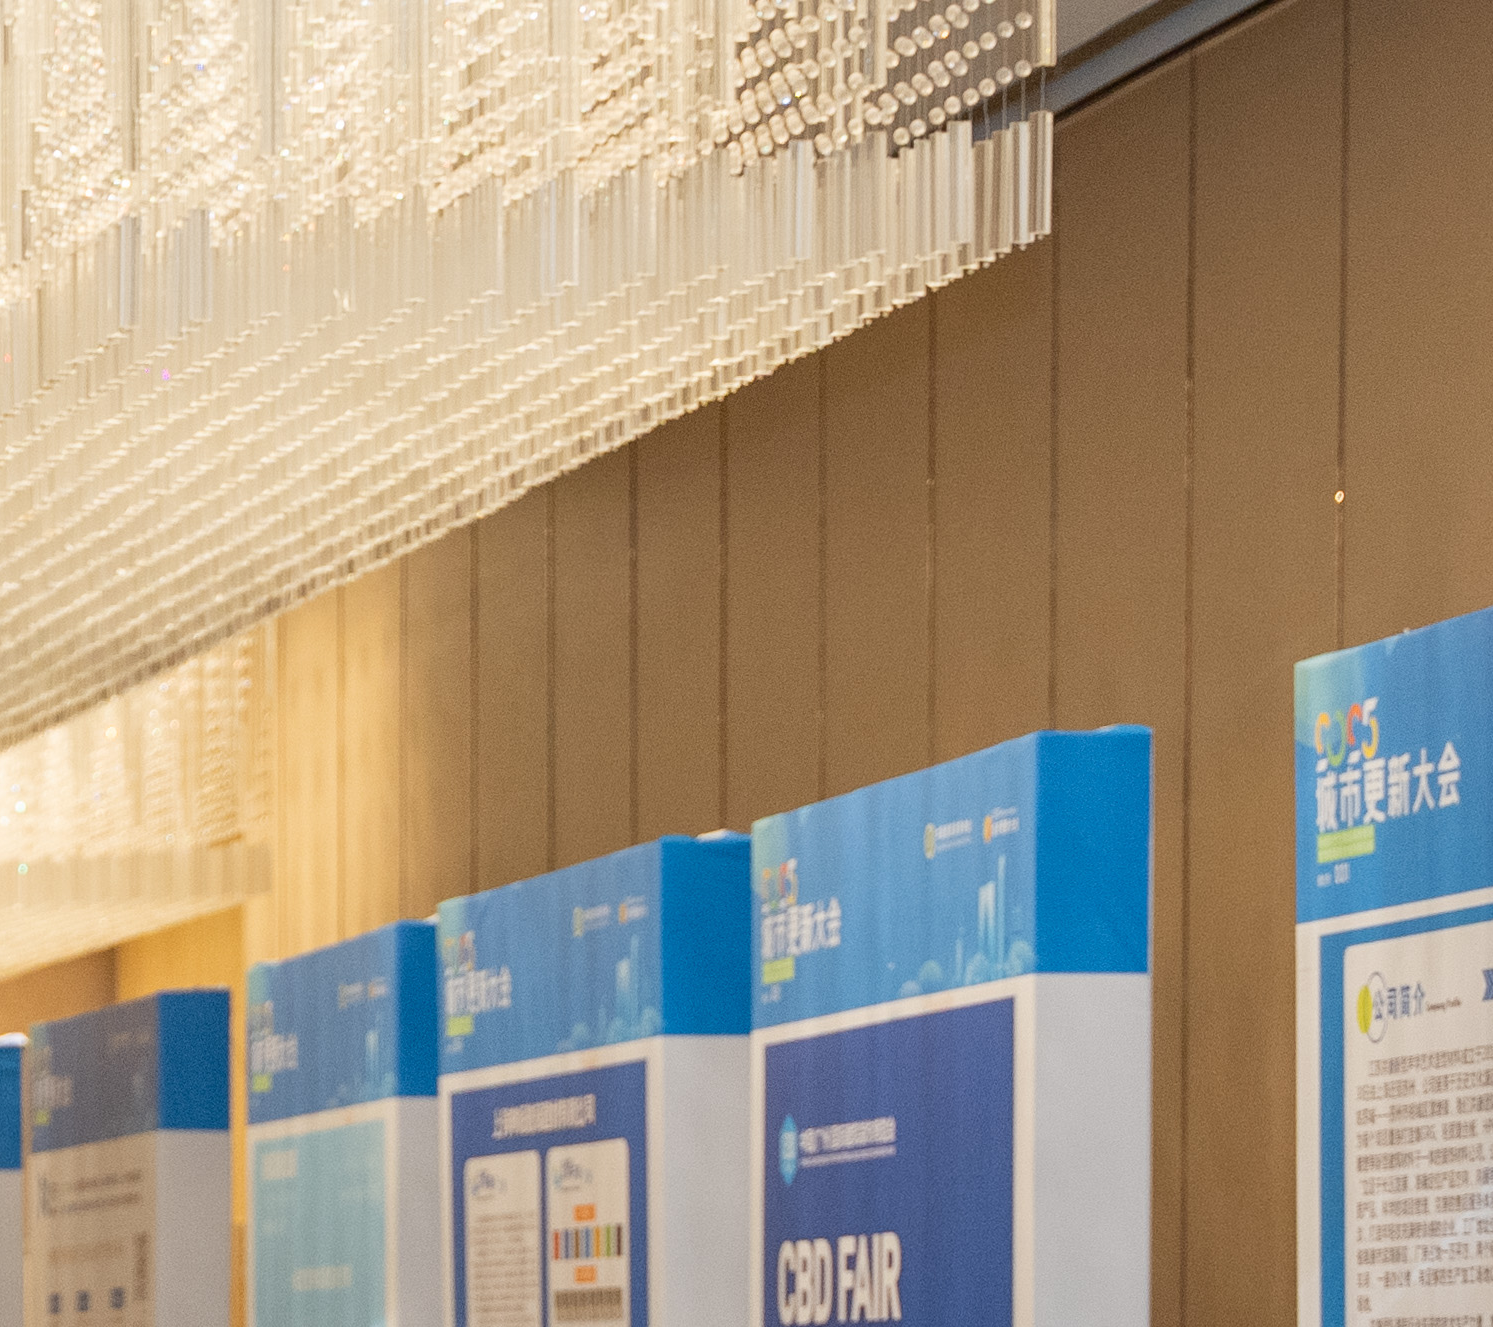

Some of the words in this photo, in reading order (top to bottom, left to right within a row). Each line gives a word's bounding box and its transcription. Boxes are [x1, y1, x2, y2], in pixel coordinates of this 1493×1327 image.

[1315, 742, 1461, 832] 城市更新大会
[777, 1238, 834, 1327] CBD
[836, 1231, 902, 1324] FAIR
